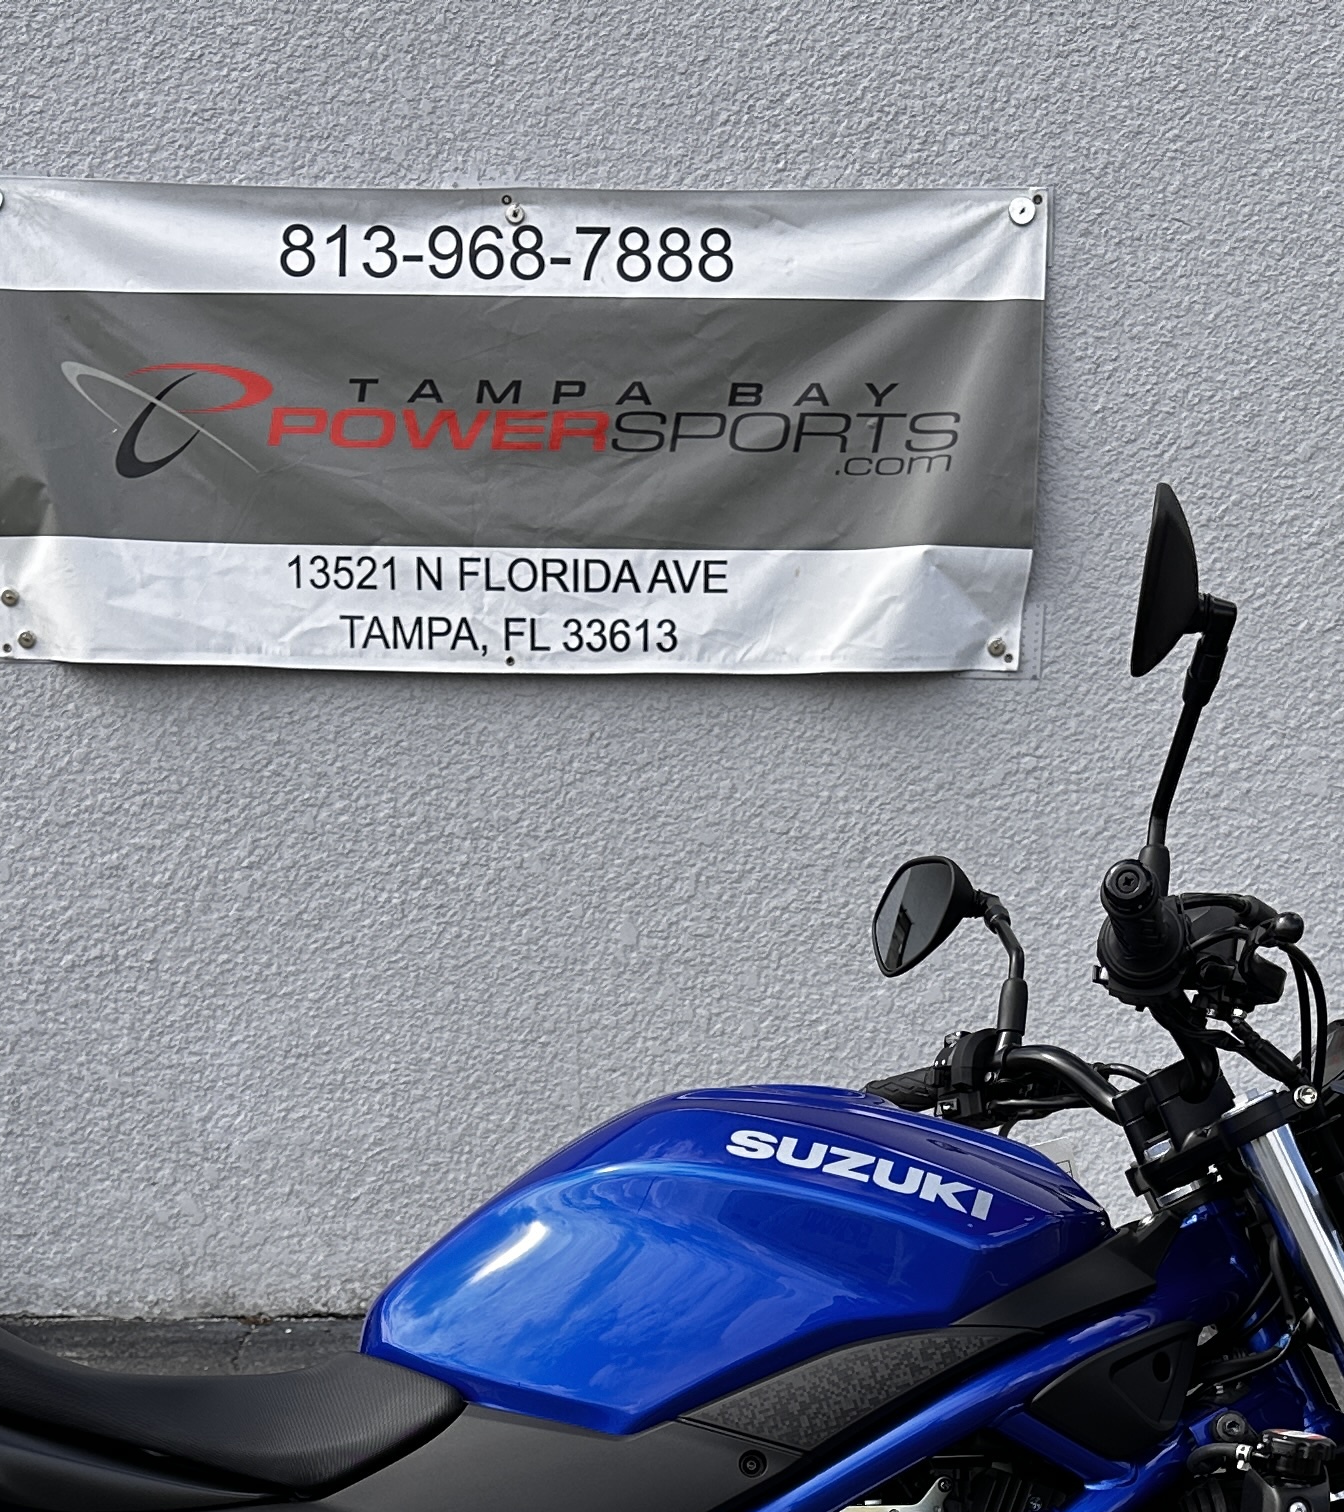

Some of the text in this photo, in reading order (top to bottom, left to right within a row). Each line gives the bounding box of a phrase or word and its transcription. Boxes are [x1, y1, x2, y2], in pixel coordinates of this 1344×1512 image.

[279, 224, 735, 283] 813-968-7888
[347, 378, 899, 407] TAMPA BAY
[267, 407, 960, 454] POWERSPORTS
[834, 453, 953, 477] .com
[287, 555, 728, 594] 13521 N FLORIDA AVE
[339, 615, 678, 657] TAMPA, FL 33613
[725, 1128, 994, 1222] SUZUKI
